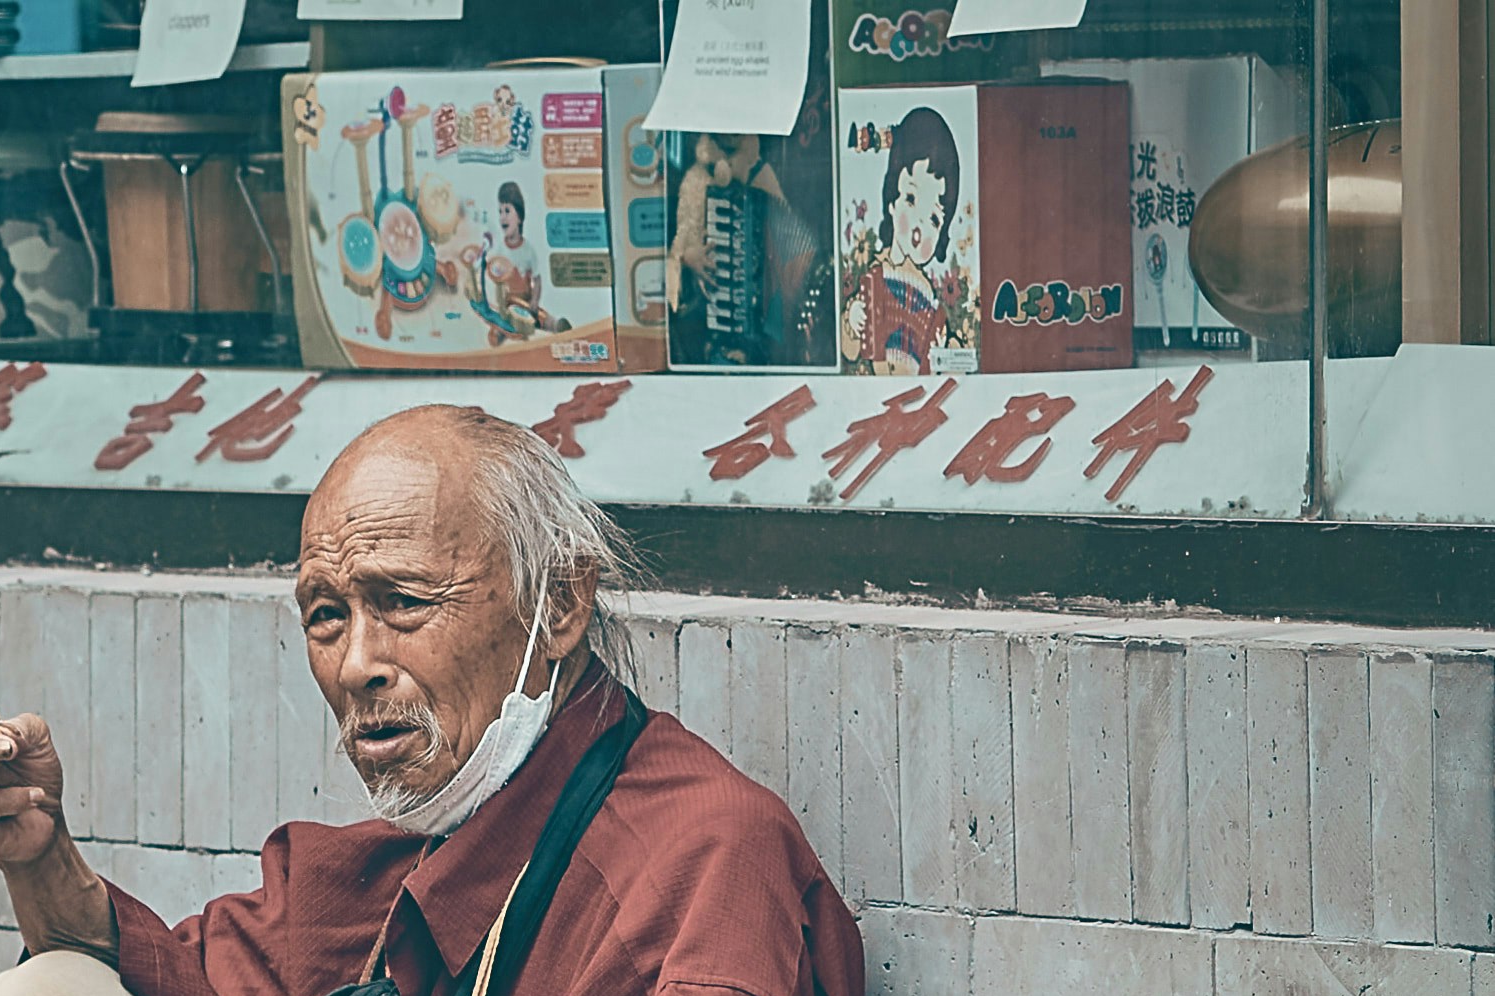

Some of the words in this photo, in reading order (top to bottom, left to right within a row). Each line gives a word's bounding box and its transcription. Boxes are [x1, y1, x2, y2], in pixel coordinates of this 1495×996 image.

[992, 279, 1124, 325] ACCORDION
[94, 372, 320, 471] 吉他
[702, 364, 1214, 501] 各种配件
